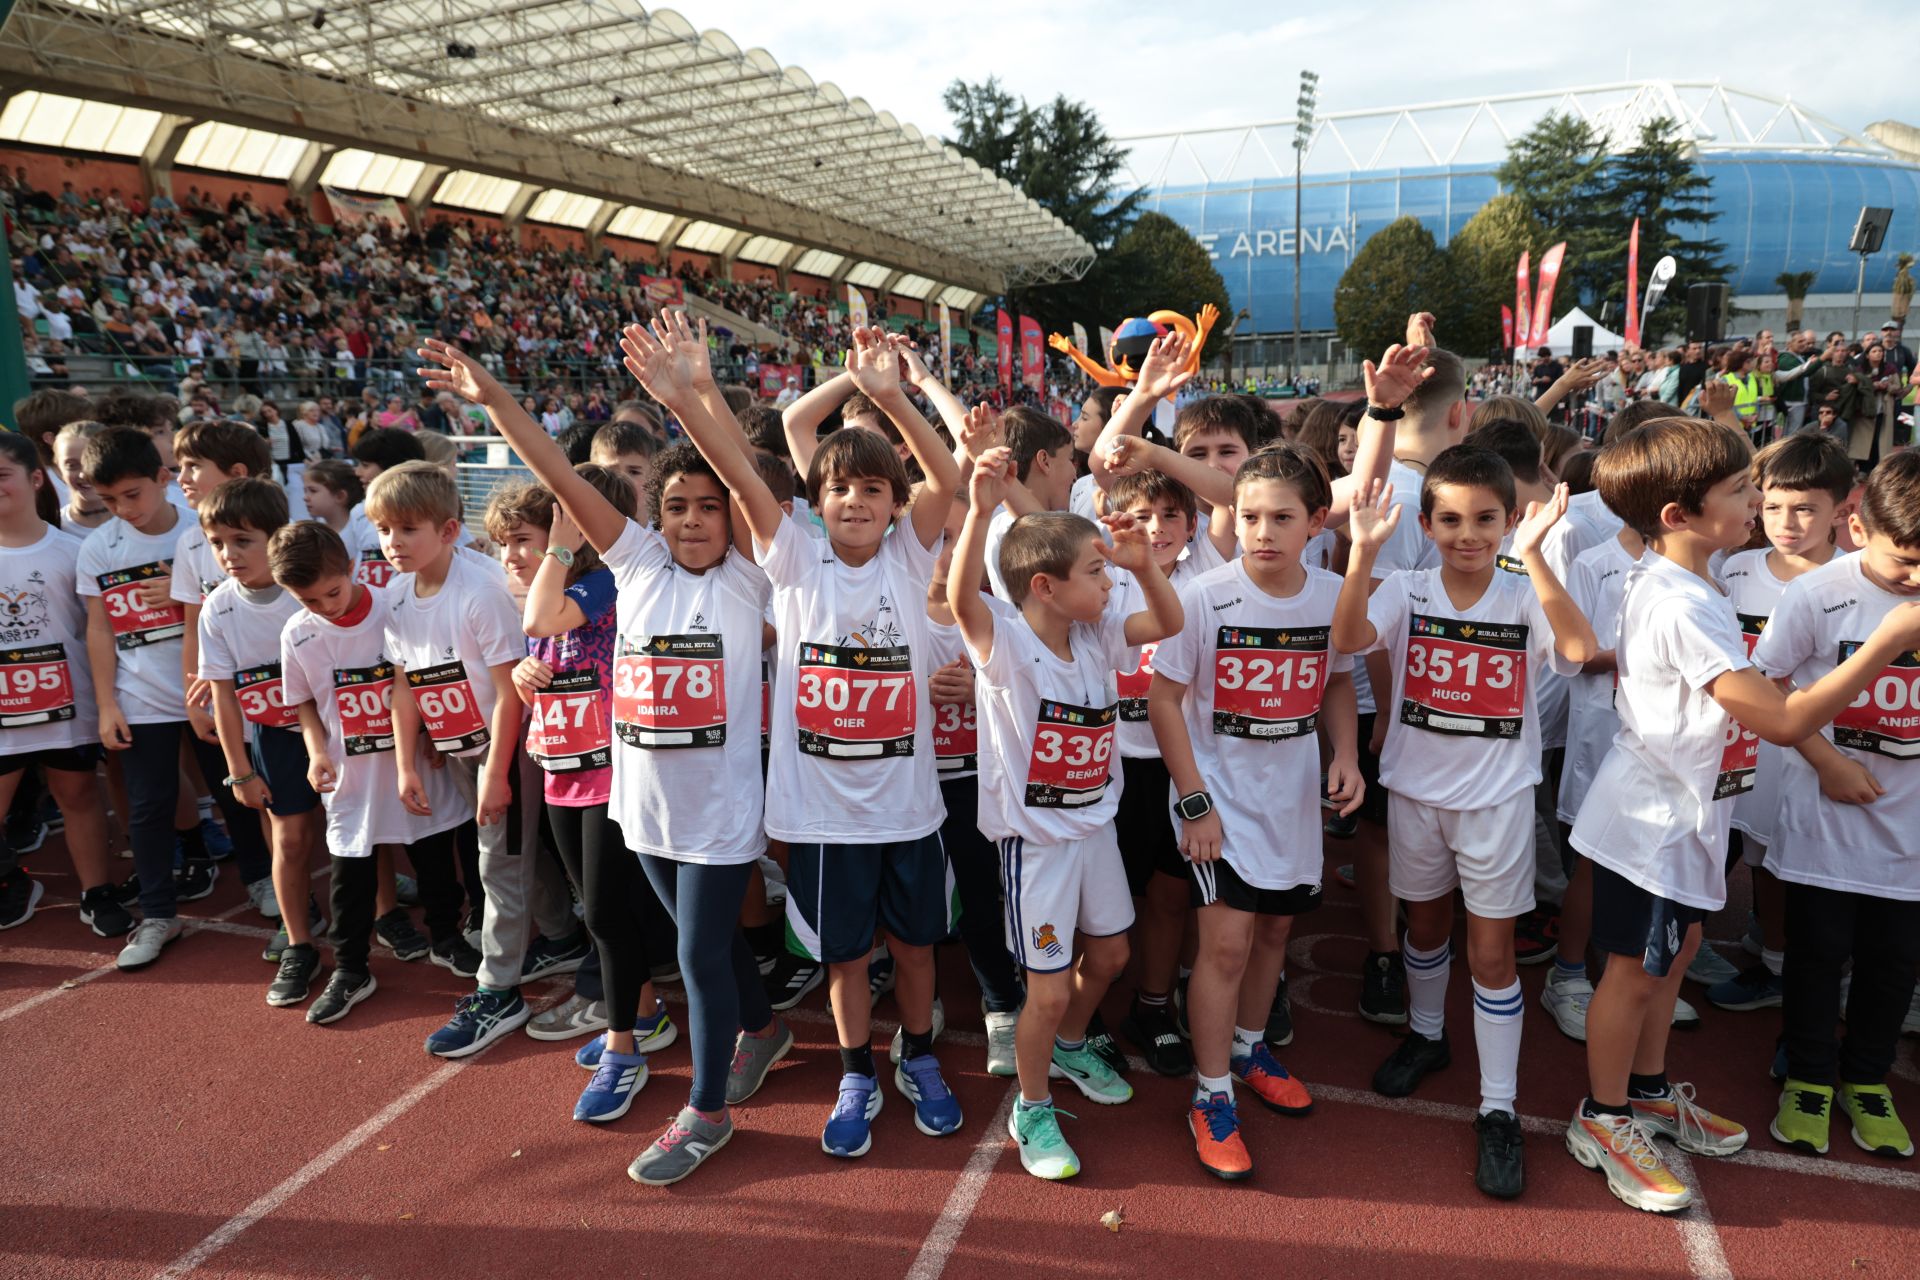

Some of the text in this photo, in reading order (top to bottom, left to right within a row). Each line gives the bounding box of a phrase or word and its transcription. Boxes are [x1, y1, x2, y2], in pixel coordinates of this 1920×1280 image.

[1229, 225, 1350, 259] ARENA
[1212, 600, 1235, 612] luanvi
[1823, 600, 1848, 614] luanvi
[139, 610, 169, 622] UNAX
[23, 629, 40, 639] 17
[1477, 630, 1500, 638] RURAL
[1408, 643, 1513, 689] 3513
[1217, 655, 1319, 692] 3215
[571, 676, 592, 684] KUTXA
[615, 664, 713, 700] 3278
[799, 673, 906, 712] 3077
[1431, 687, 1472, 702] HUGO
[1, 696, 32, 706] UXUE
[1260, 697, 1282, 707] IAN
[637, 705, 679, 716] IDAIRA
[833, 717, 866, 728] OIER
[1154, 1033, 1181, 1048] PUMA
